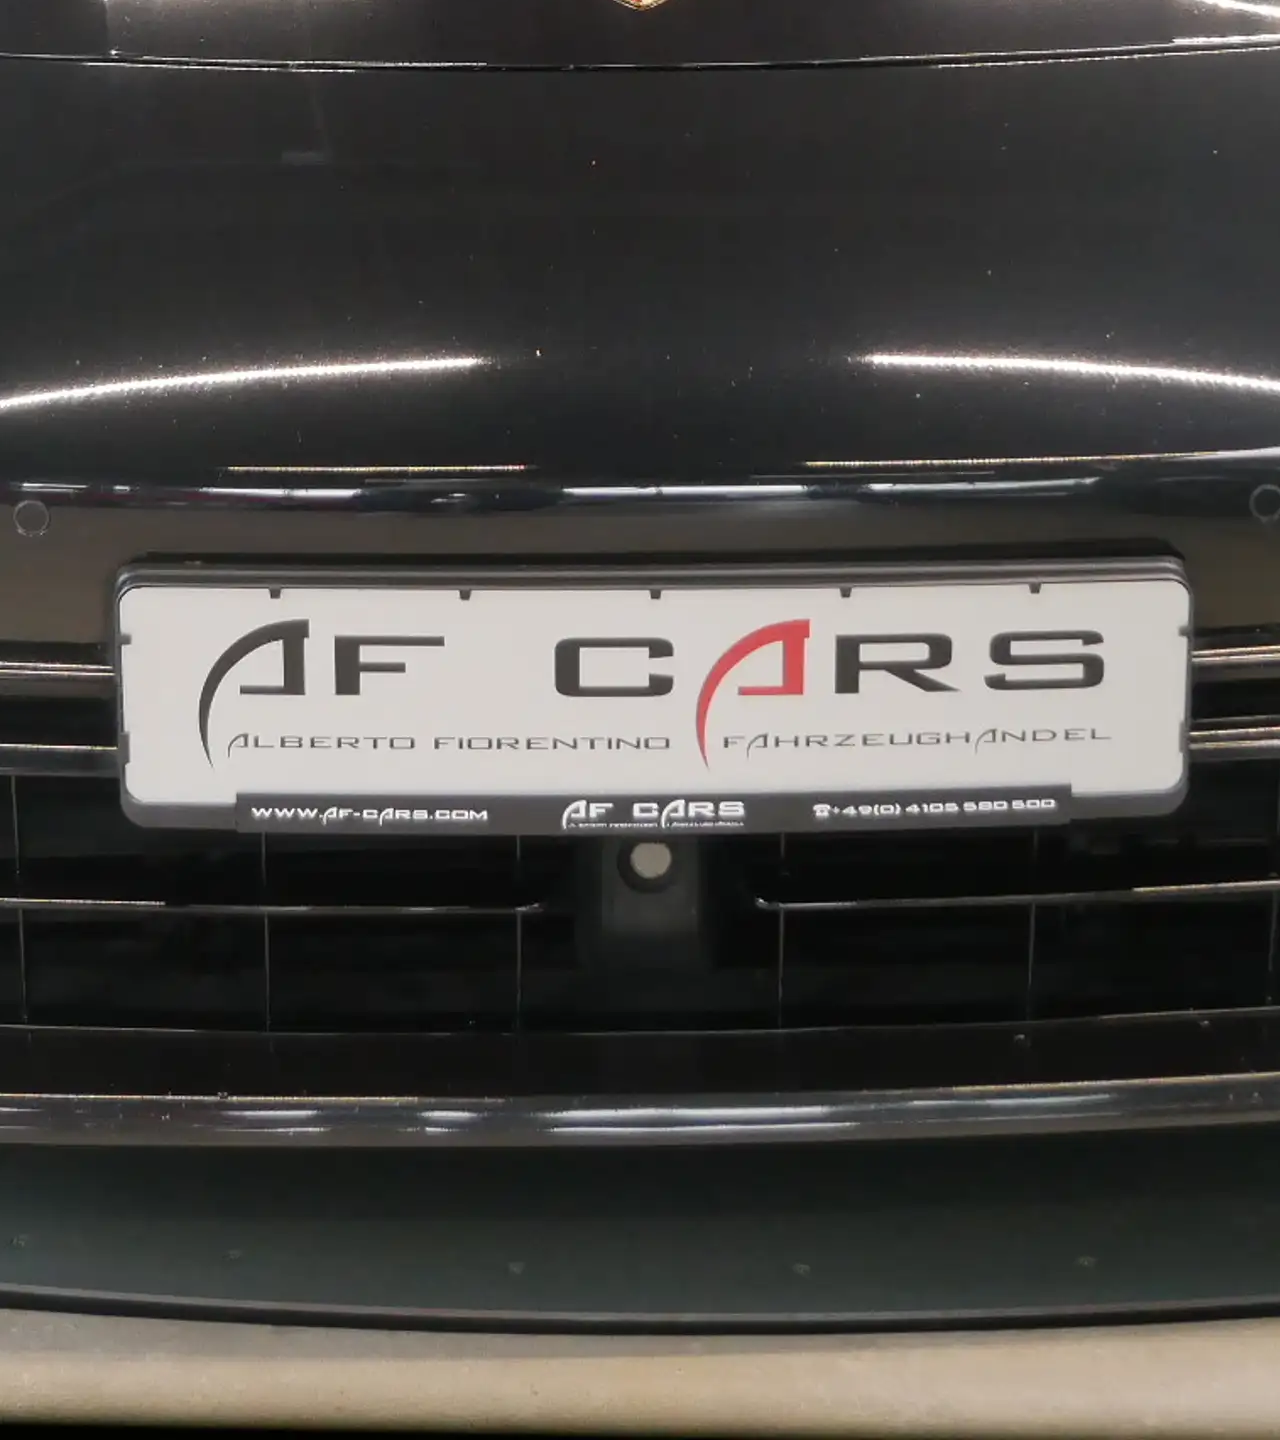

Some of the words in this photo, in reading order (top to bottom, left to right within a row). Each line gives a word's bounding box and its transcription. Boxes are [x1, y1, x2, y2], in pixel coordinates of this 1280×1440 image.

[199, 618, 445, 769] AF
[554, 618, 1105, 770] CARS
[227, 732, 416, 758] ALBERTO
[433, 736, 671, 751] FIORENTINO
[723, 728, 1112, 758] FAHRZEUGHANDEL
[561, 799, 614, 829] AF
[632, 799, 746, 829] CARS
